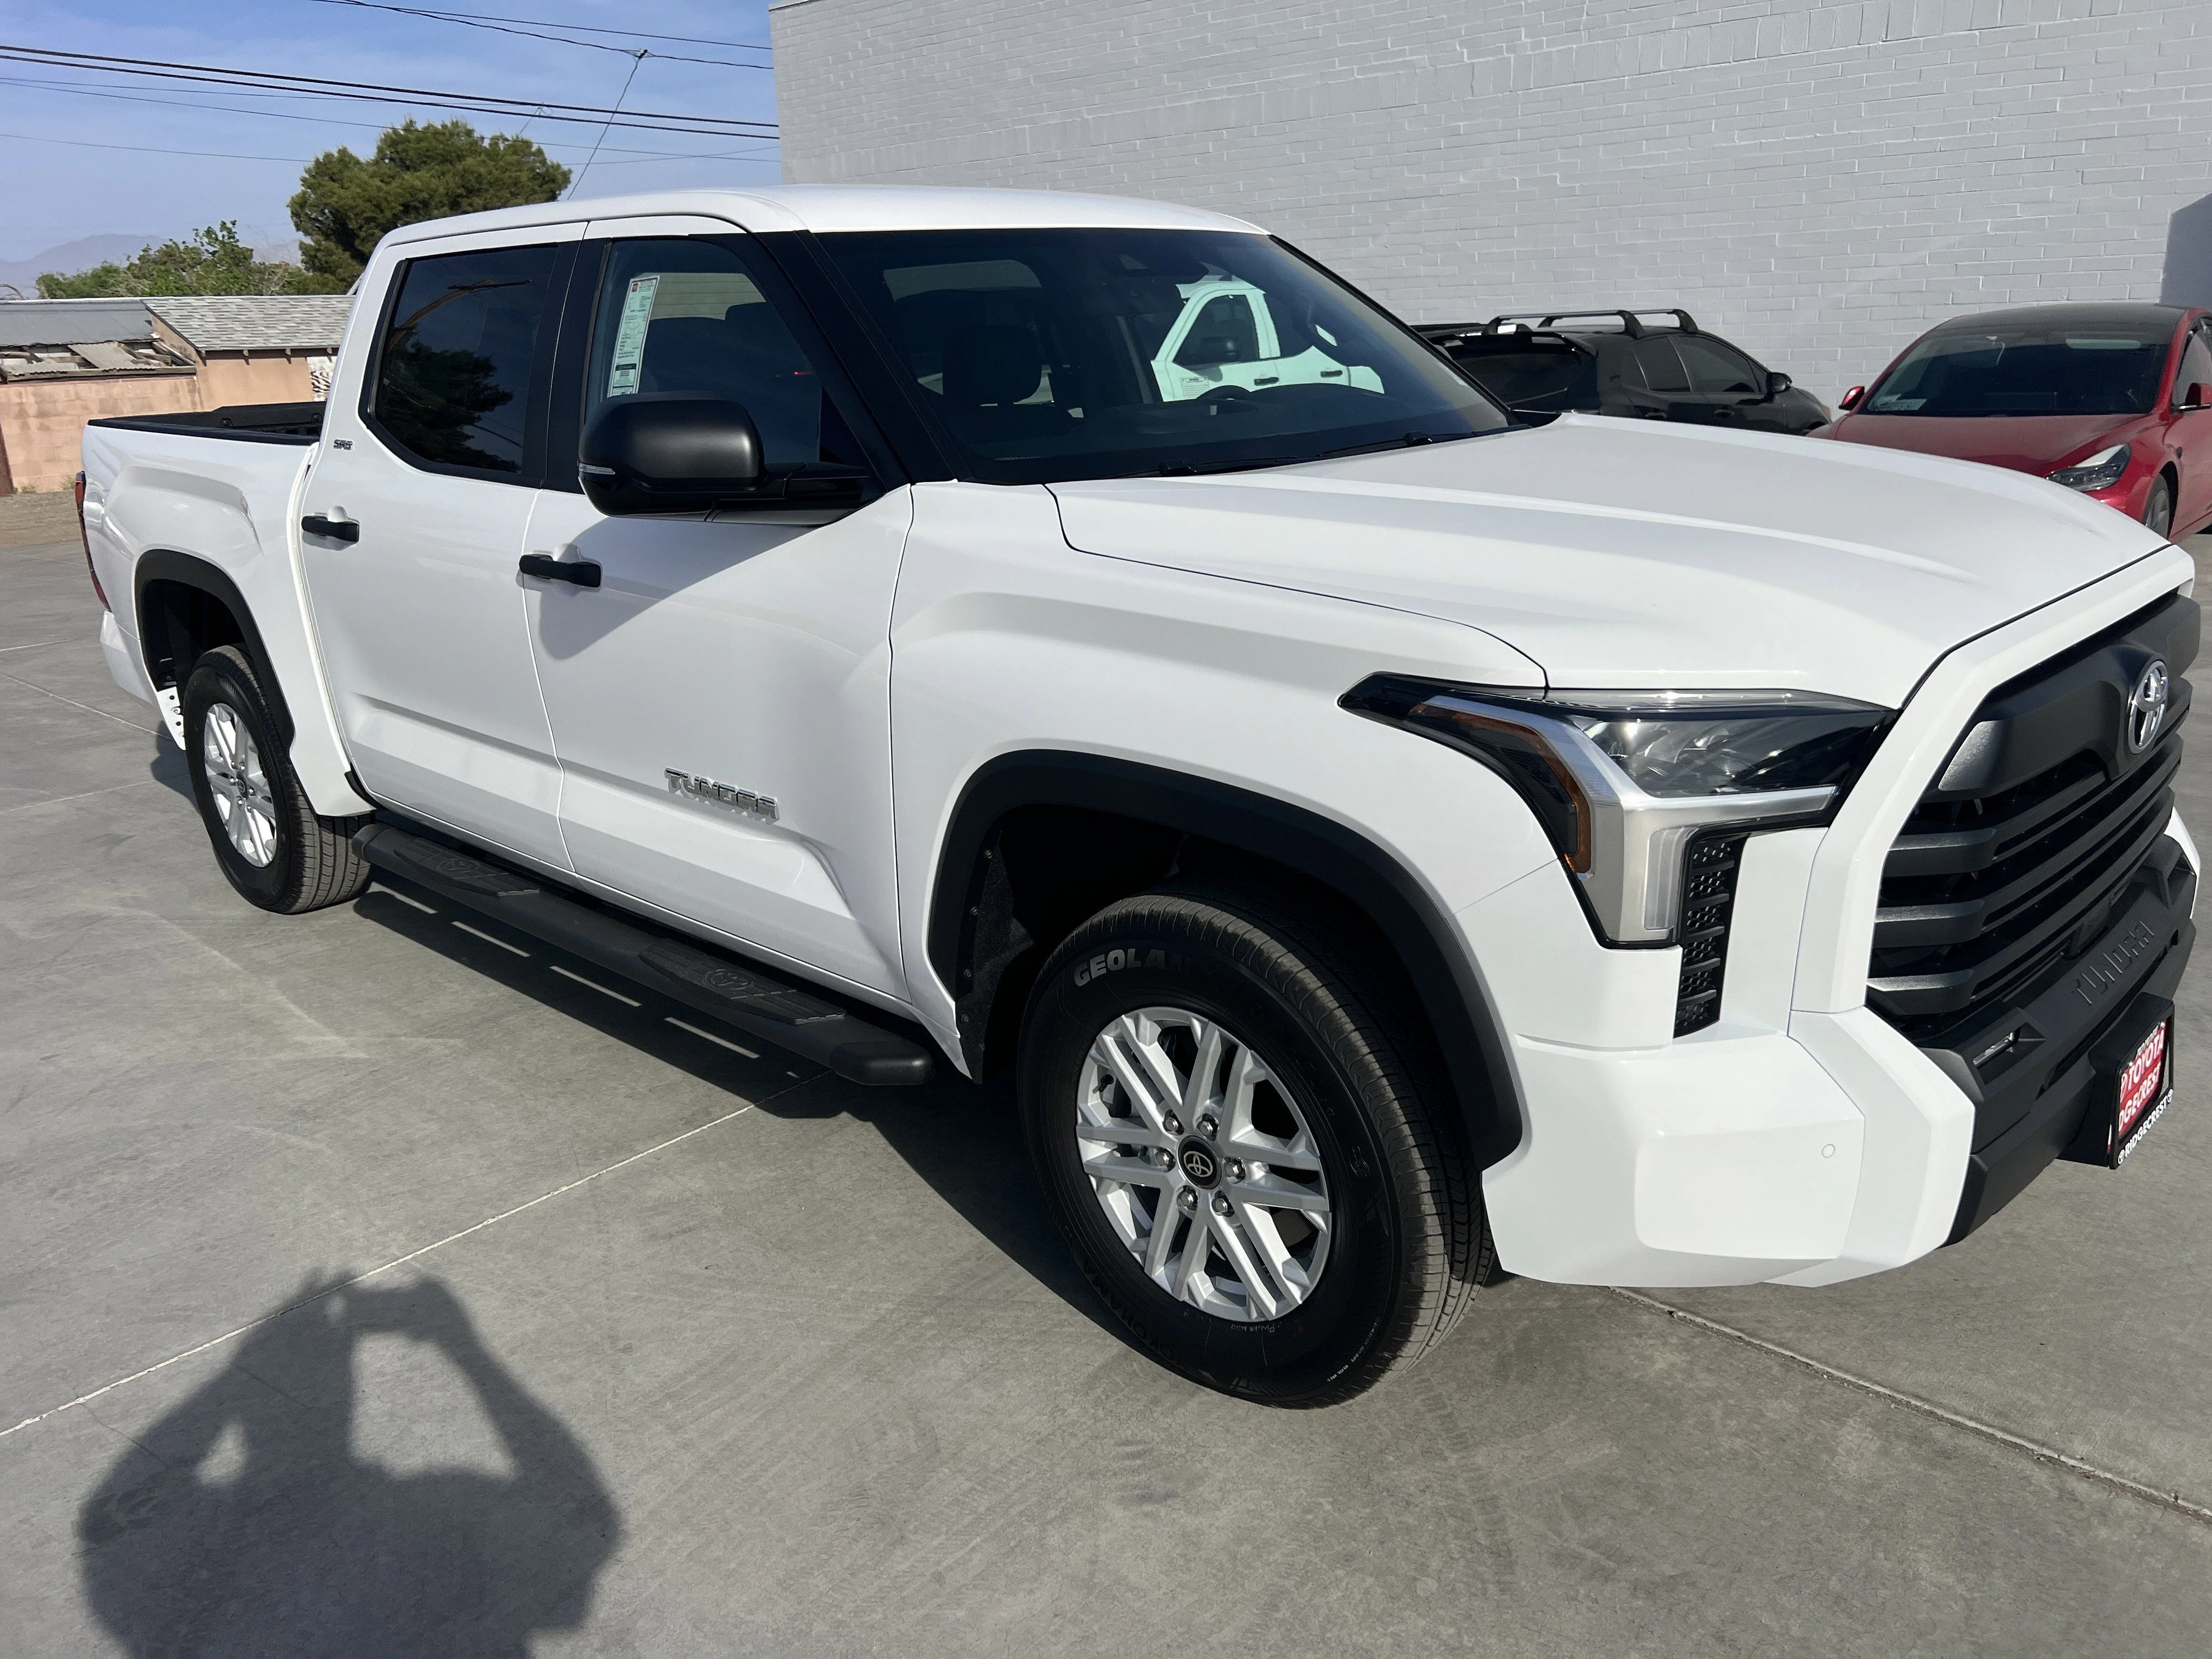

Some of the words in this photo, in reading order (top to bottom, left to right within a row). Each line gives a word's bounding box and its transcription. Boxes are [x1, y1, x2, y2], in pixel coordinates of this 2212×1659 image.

[664, 766, 779, 823] TUNDRA
[2072, 920, 2154, 1005] TUNDRA
[2127, 1029, 2165, 1091] TOYOTA
[2125, 1098, 2168, 1158] RIDGECREST
